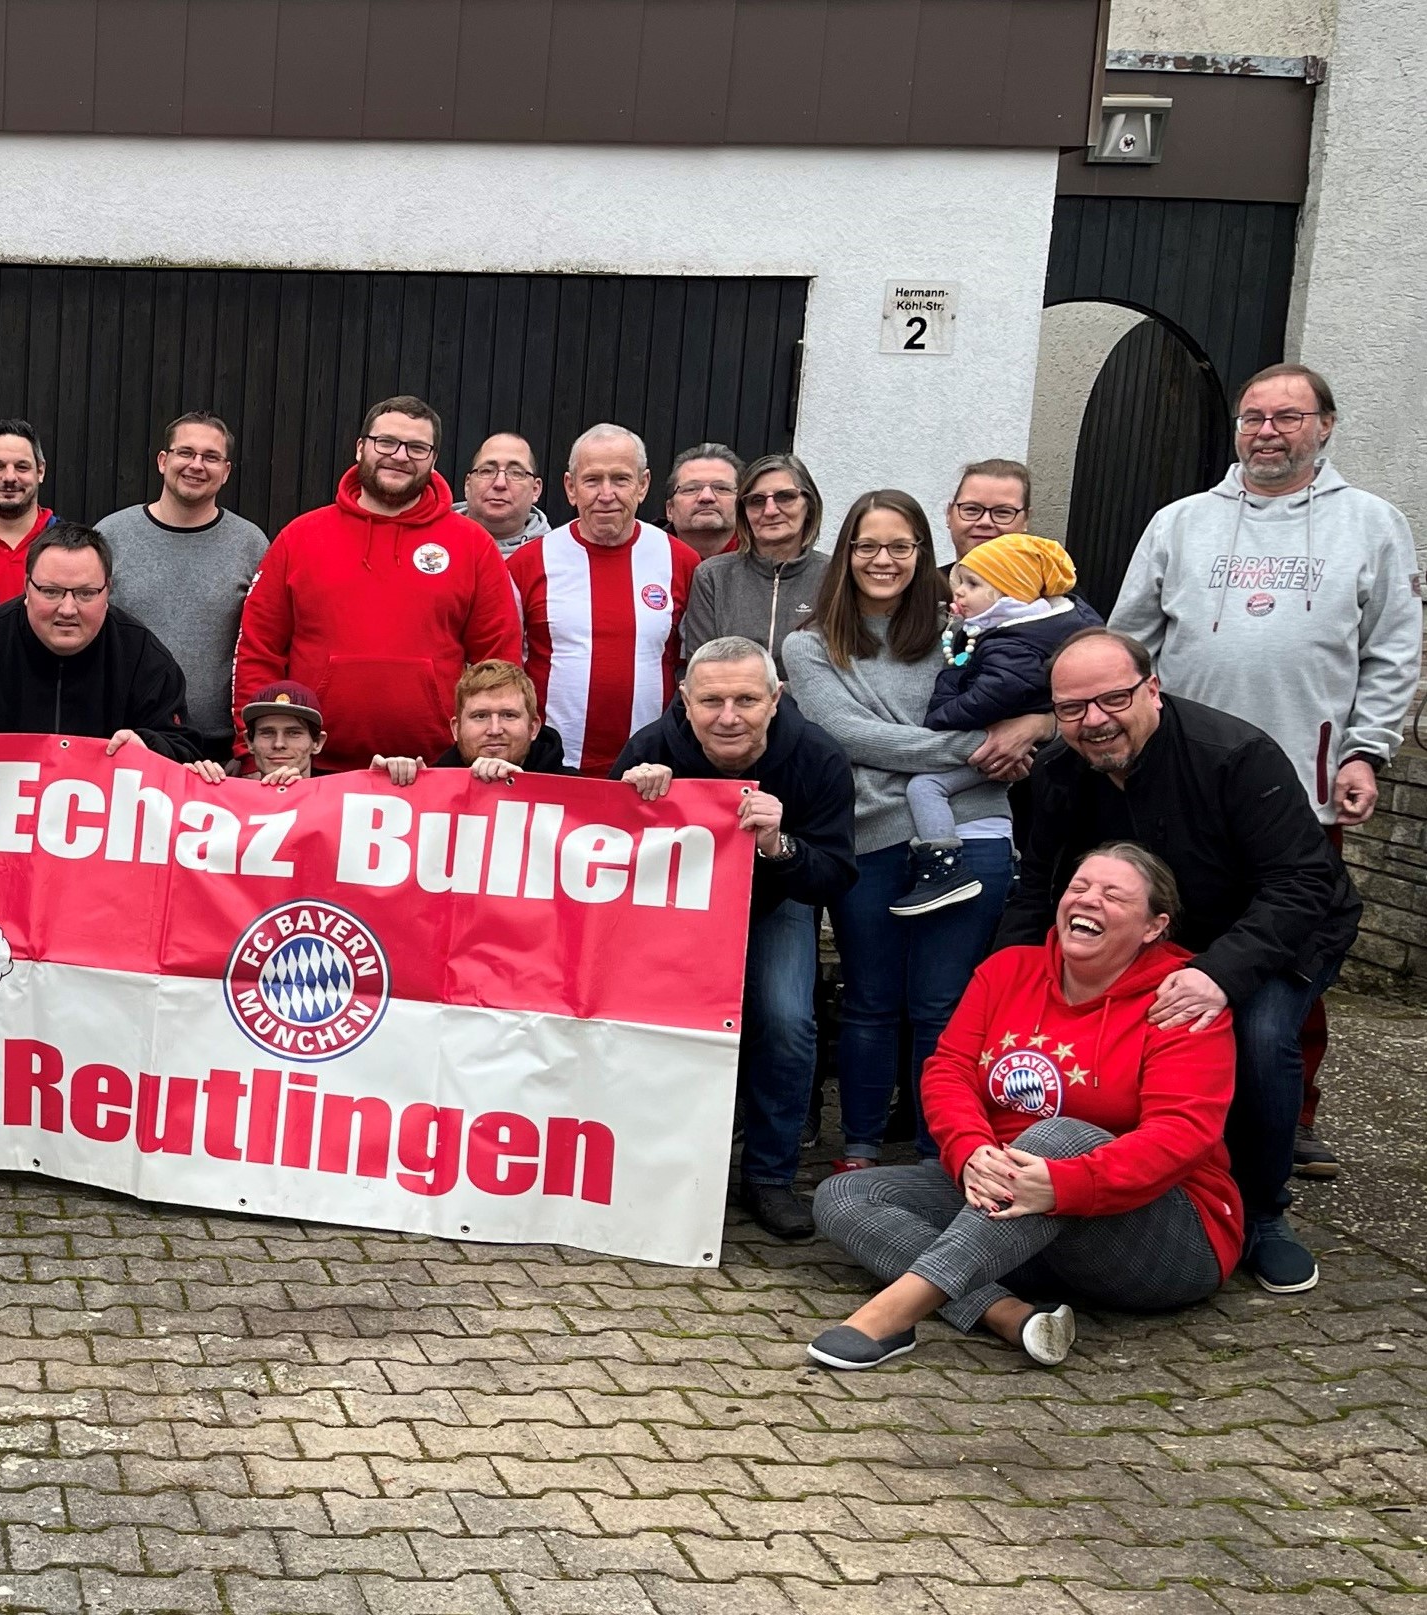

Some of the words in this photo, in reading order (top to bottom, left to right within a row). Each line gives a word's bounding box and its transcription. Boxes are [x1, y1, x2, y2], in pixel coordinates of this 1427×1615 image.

[895, 287, 949, 298] Hermann-
[903, 316, 928, 350] 2
[1211, 555, 1242, 574] FC
[1242, 556, 1326, 577] BAYERN
[336, 793, 716, 911] Bullen
[241, 931, 274, 968] FC
[275, 909, 379, 977] BAYERN
[236, 988, 374, 1052] MÜNCHEN
[994, 1063, 1010, 1082] FC
[1010, 1055, 1058, 1091] BAYERN
[4, 1038, 615, 1205] Reutlingen
